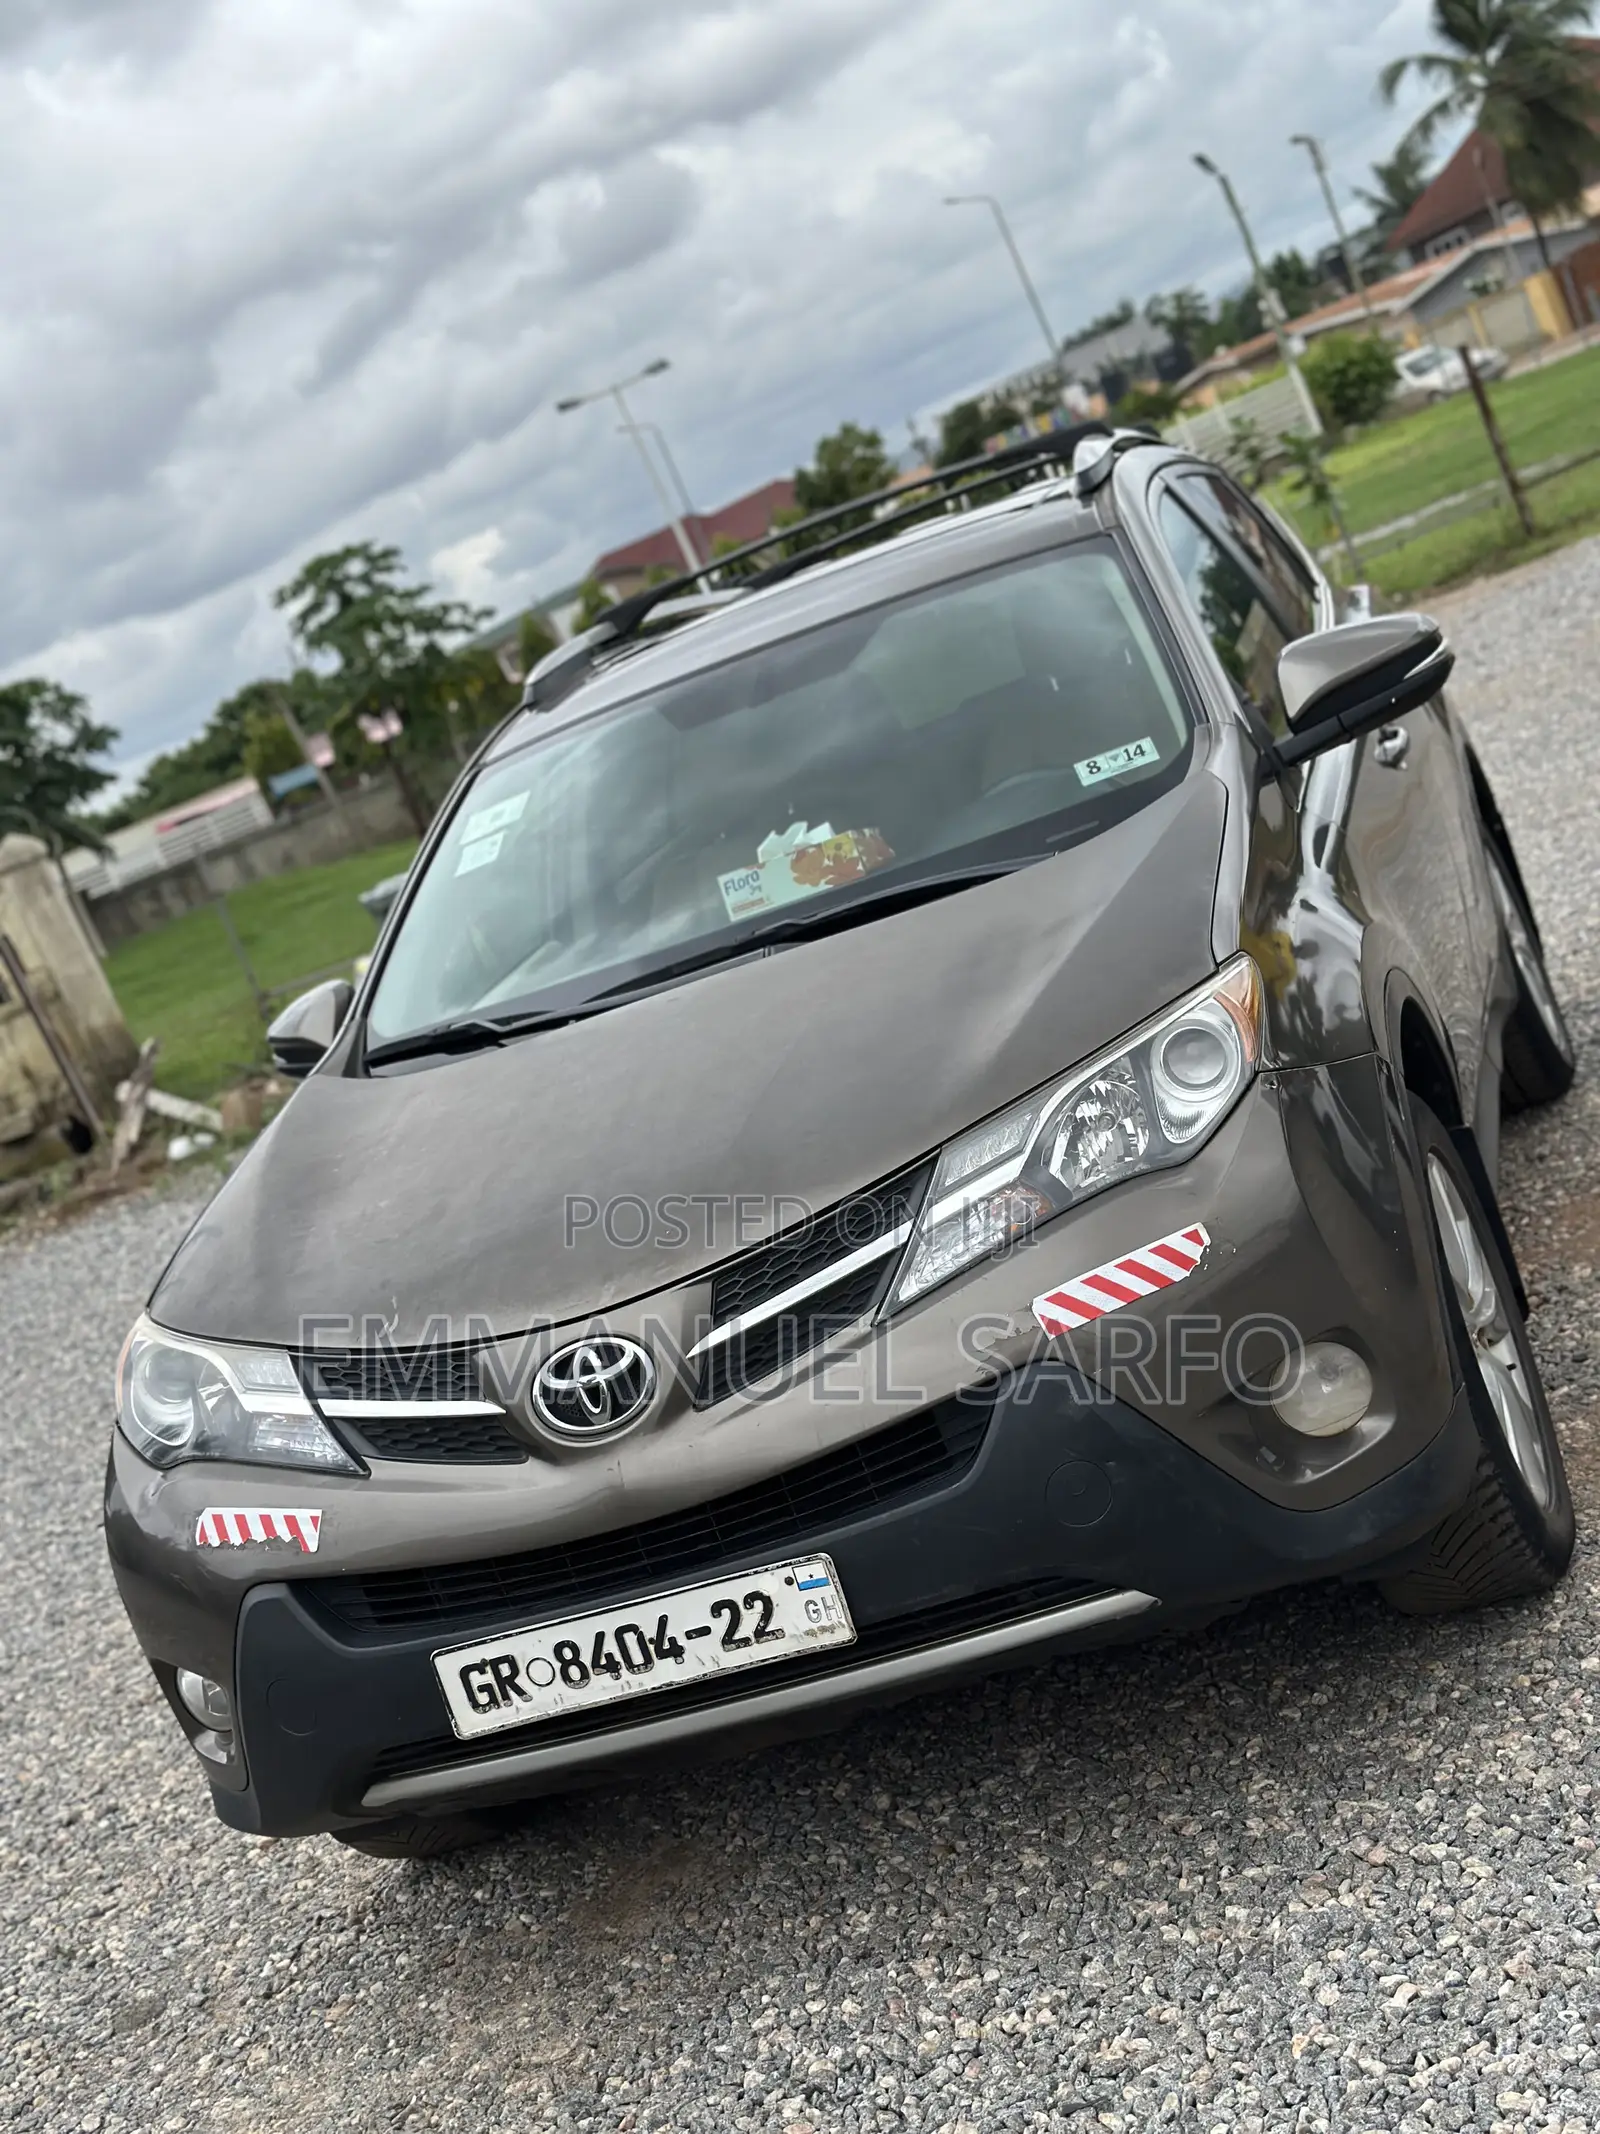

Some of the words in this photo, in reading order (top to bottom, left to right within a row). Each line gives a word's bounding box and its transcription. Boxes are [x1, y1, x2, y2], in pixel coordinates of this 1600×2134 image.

[1086, 760, 1101, 775] 8
[1123, 744, 1146, 762] 14
[723, 869, 761, 897] Flora
[804, 1594, 843, 1624] GH
